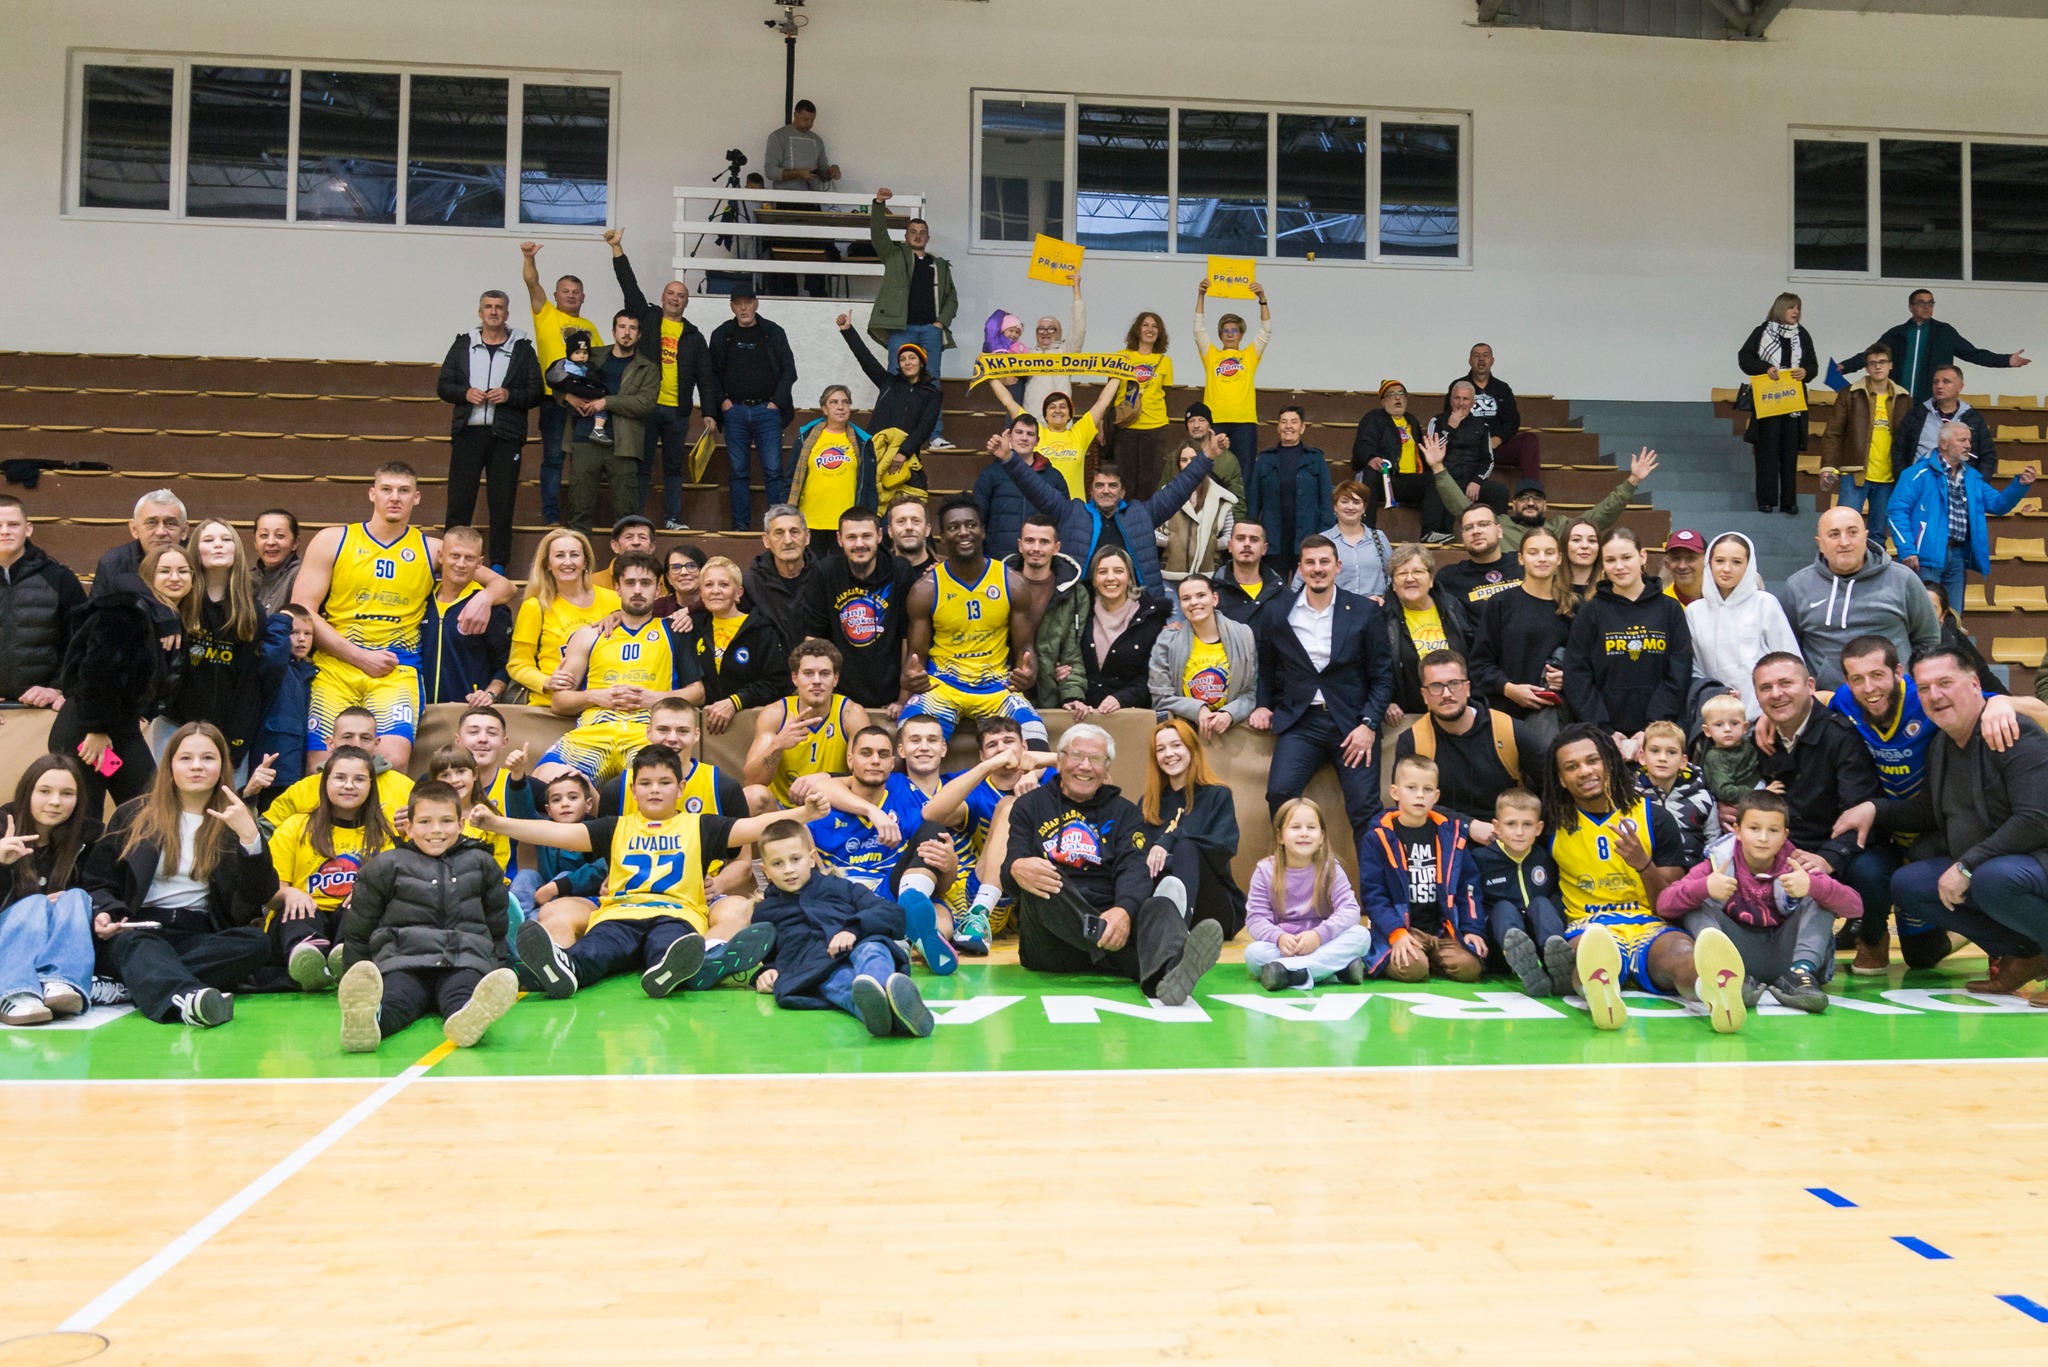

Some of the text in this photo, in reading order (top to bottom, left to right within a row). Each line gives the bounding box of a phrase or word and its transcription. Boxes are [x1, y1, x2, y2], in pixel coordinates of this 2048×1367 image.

[985, 358, 1007, 370] KK
[375, 559, 395, 579] 50
[966, 600, 981, 620] 13
[622, 644, 641, 661] 00
[392, 704, 412, 723] 50
[810, 742, 817, 763] 1
[1411, 842, 1432, 859] AM
[1597, 836, 1610, 860] 8
[1409, 867, 1436, 884] TUR
[1408, 884, 1437, 903] OSS
